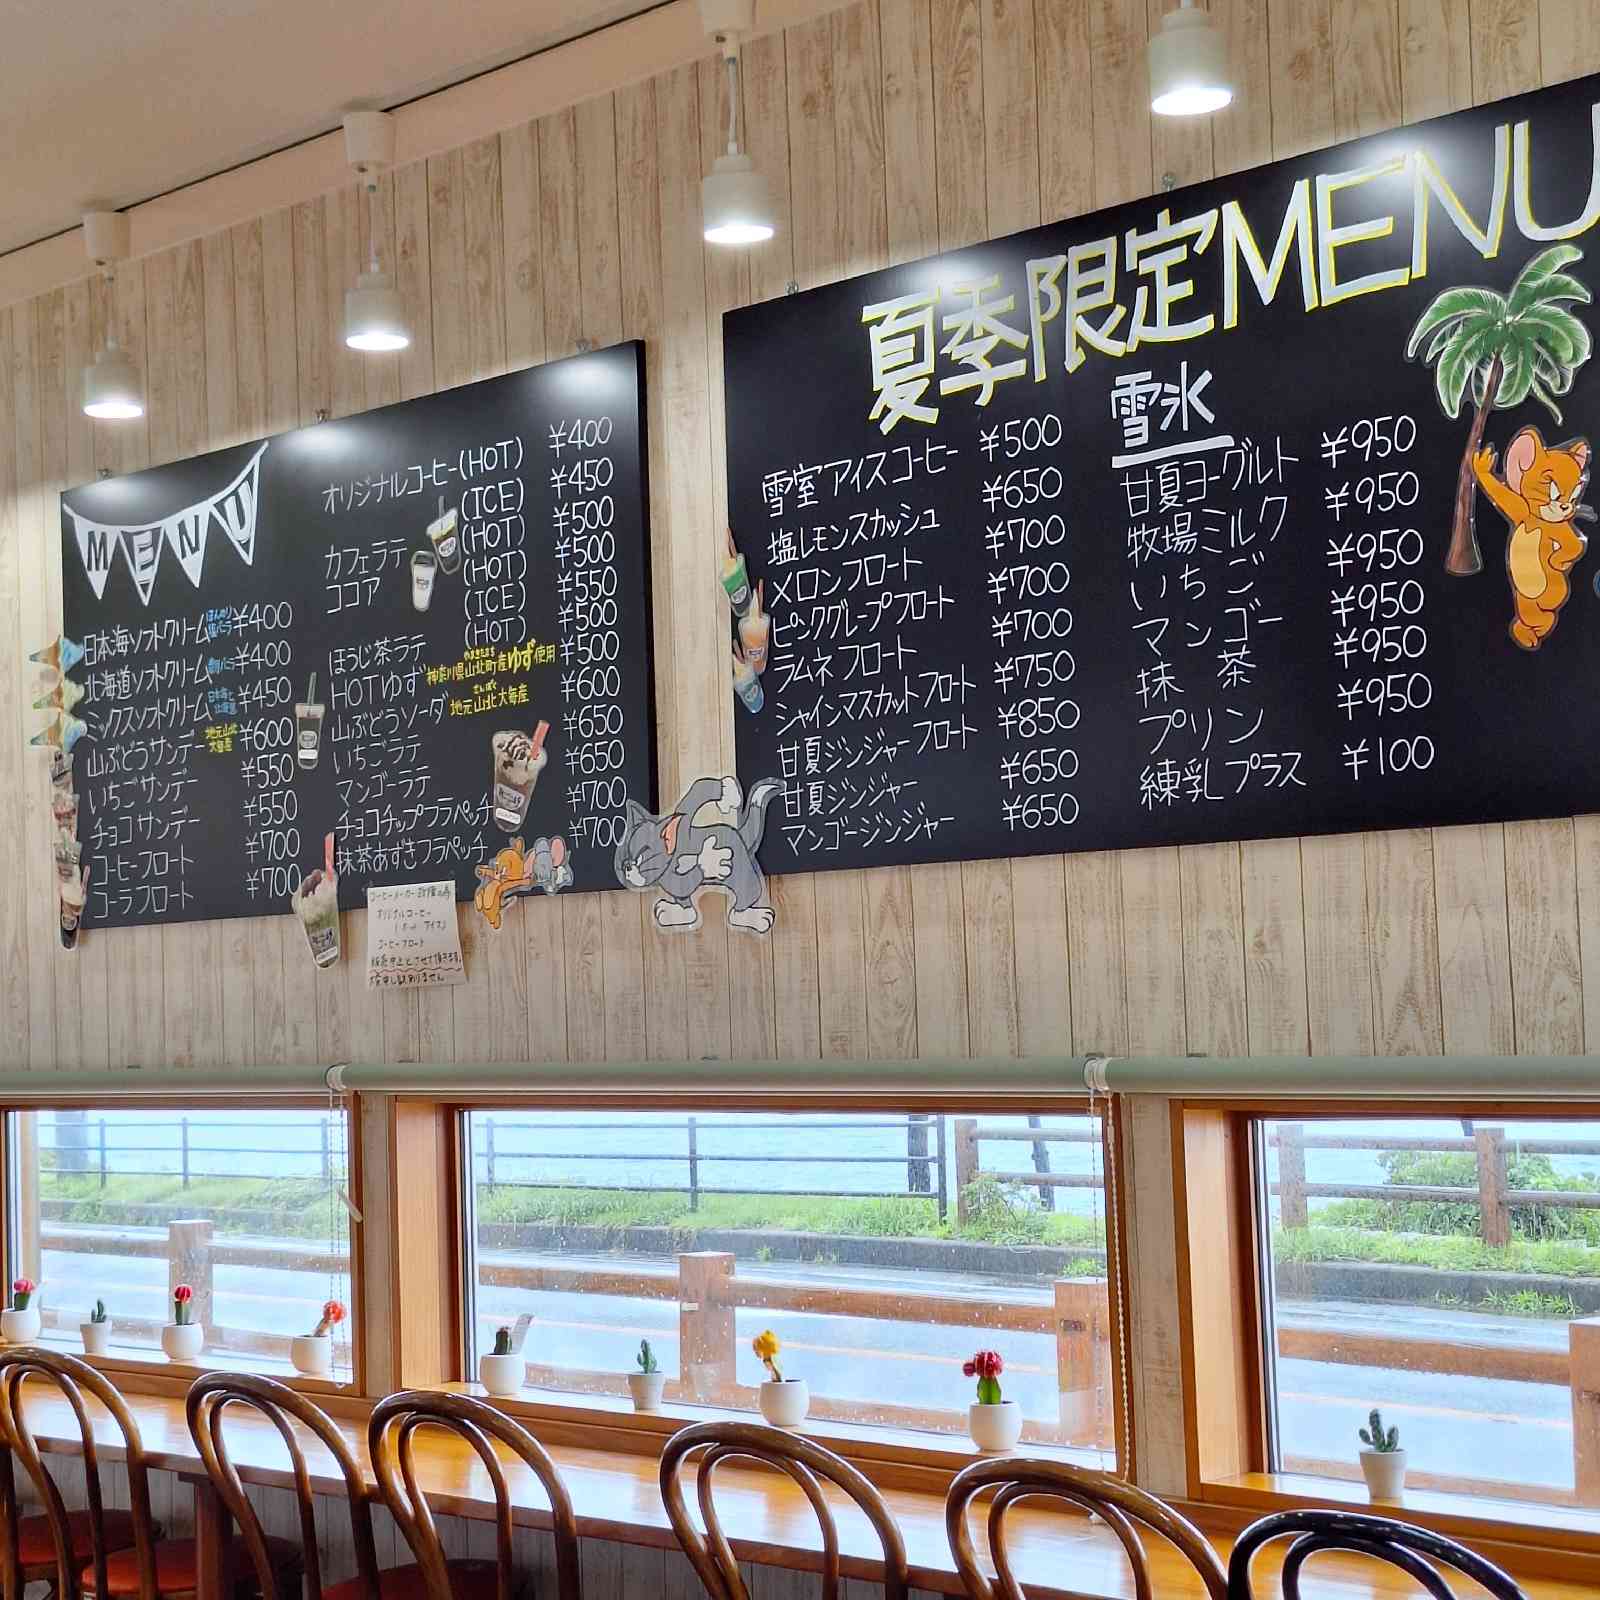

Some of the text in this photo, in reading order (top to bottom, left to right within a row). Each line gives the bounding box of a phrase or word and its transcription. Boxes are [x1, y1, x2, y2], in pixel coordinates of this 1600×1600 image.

[1110, 360, 1216, 448] 雪氷
[549, 416, 612, 457] ¥400
[979, 414, 1062, 462] ¥500
[1120, 415, 1417, 517] 甘夏ヨーグルト ¥950
[461, 457, 614, 521] (ICE) ¥450
[768, 467, 1063, 565] 塩レモンスカッシュ ¥650
[1128, 471, 1420, 568] 牧場ミルク ¥950
[325, 538, 408, 580] カフェラテ
[461, 514, 525, 555] (HOT)
[553, 496, 615, 536] ¥500
[770, 515, 1066, 608] メロンフロート ¥700
[1326, 529, 1424, 577] ¥950
[326, 531, 616, 614] ココア (HOT) ¥500
[464, 566, 617, 620] (ICE) ¥550
[773, 562, 1070, 647] ピンクグレープフロート ¥700
[1331, 580, 1425, 627] ¥950
[84, 601, 293, 666] 日本海ソフトクリーム ¥400
[329, 599, 618, 676] ほうじ茶ラテ (HOT) ¥500
[559, 630, 620, 666] ¥500
[774, 608, 1073, 693] ラムネフロート ¥700
[1333, 625, 1427, 669] ¥950
[84, 640, 291, 704] 北海道ソフトクリーム ¥400
[331, 689, 450, 742] 山ぶどうソーダ
[560, 666, 621, 702] ¥600
[776, 650, 1076, 736] シャインマスカットフロート ¥750
[87, 676, 292, 742] ミックスソフトクリーム ¥450
[333, 733, 423, 775] いちごラテ
[563, 704, 624, 740] ¥650
[997, 697, 1080, 740] ¥850
[1138, 672, 1433, 754] プリン ¥950
[87, 728, 205, 777] 山ぶどうサンデー
[239, 717, 294, 751] ¥600
[336, 739, 625, 807] マンゴーラテ ¥650
[1342, 735, 1435, 781] ¥100
[89, 753, 294, 815] いちごサンデー ¥550
[566, 776, 627, 813] ¥700
[780, 748, 1079, 818] 甘夏ジンジャー ¥650
[90, 790, 298, 849] チョコサンデー ¥550
[568, 815, 627, 848] ¥700
[782, 793, 1080, 856] マンゴージンジャー ¥650
[92, 828, 300, 886] コーヒーフロート ¥700
[93, 864, 301, 918] コーラフロート ¥700
